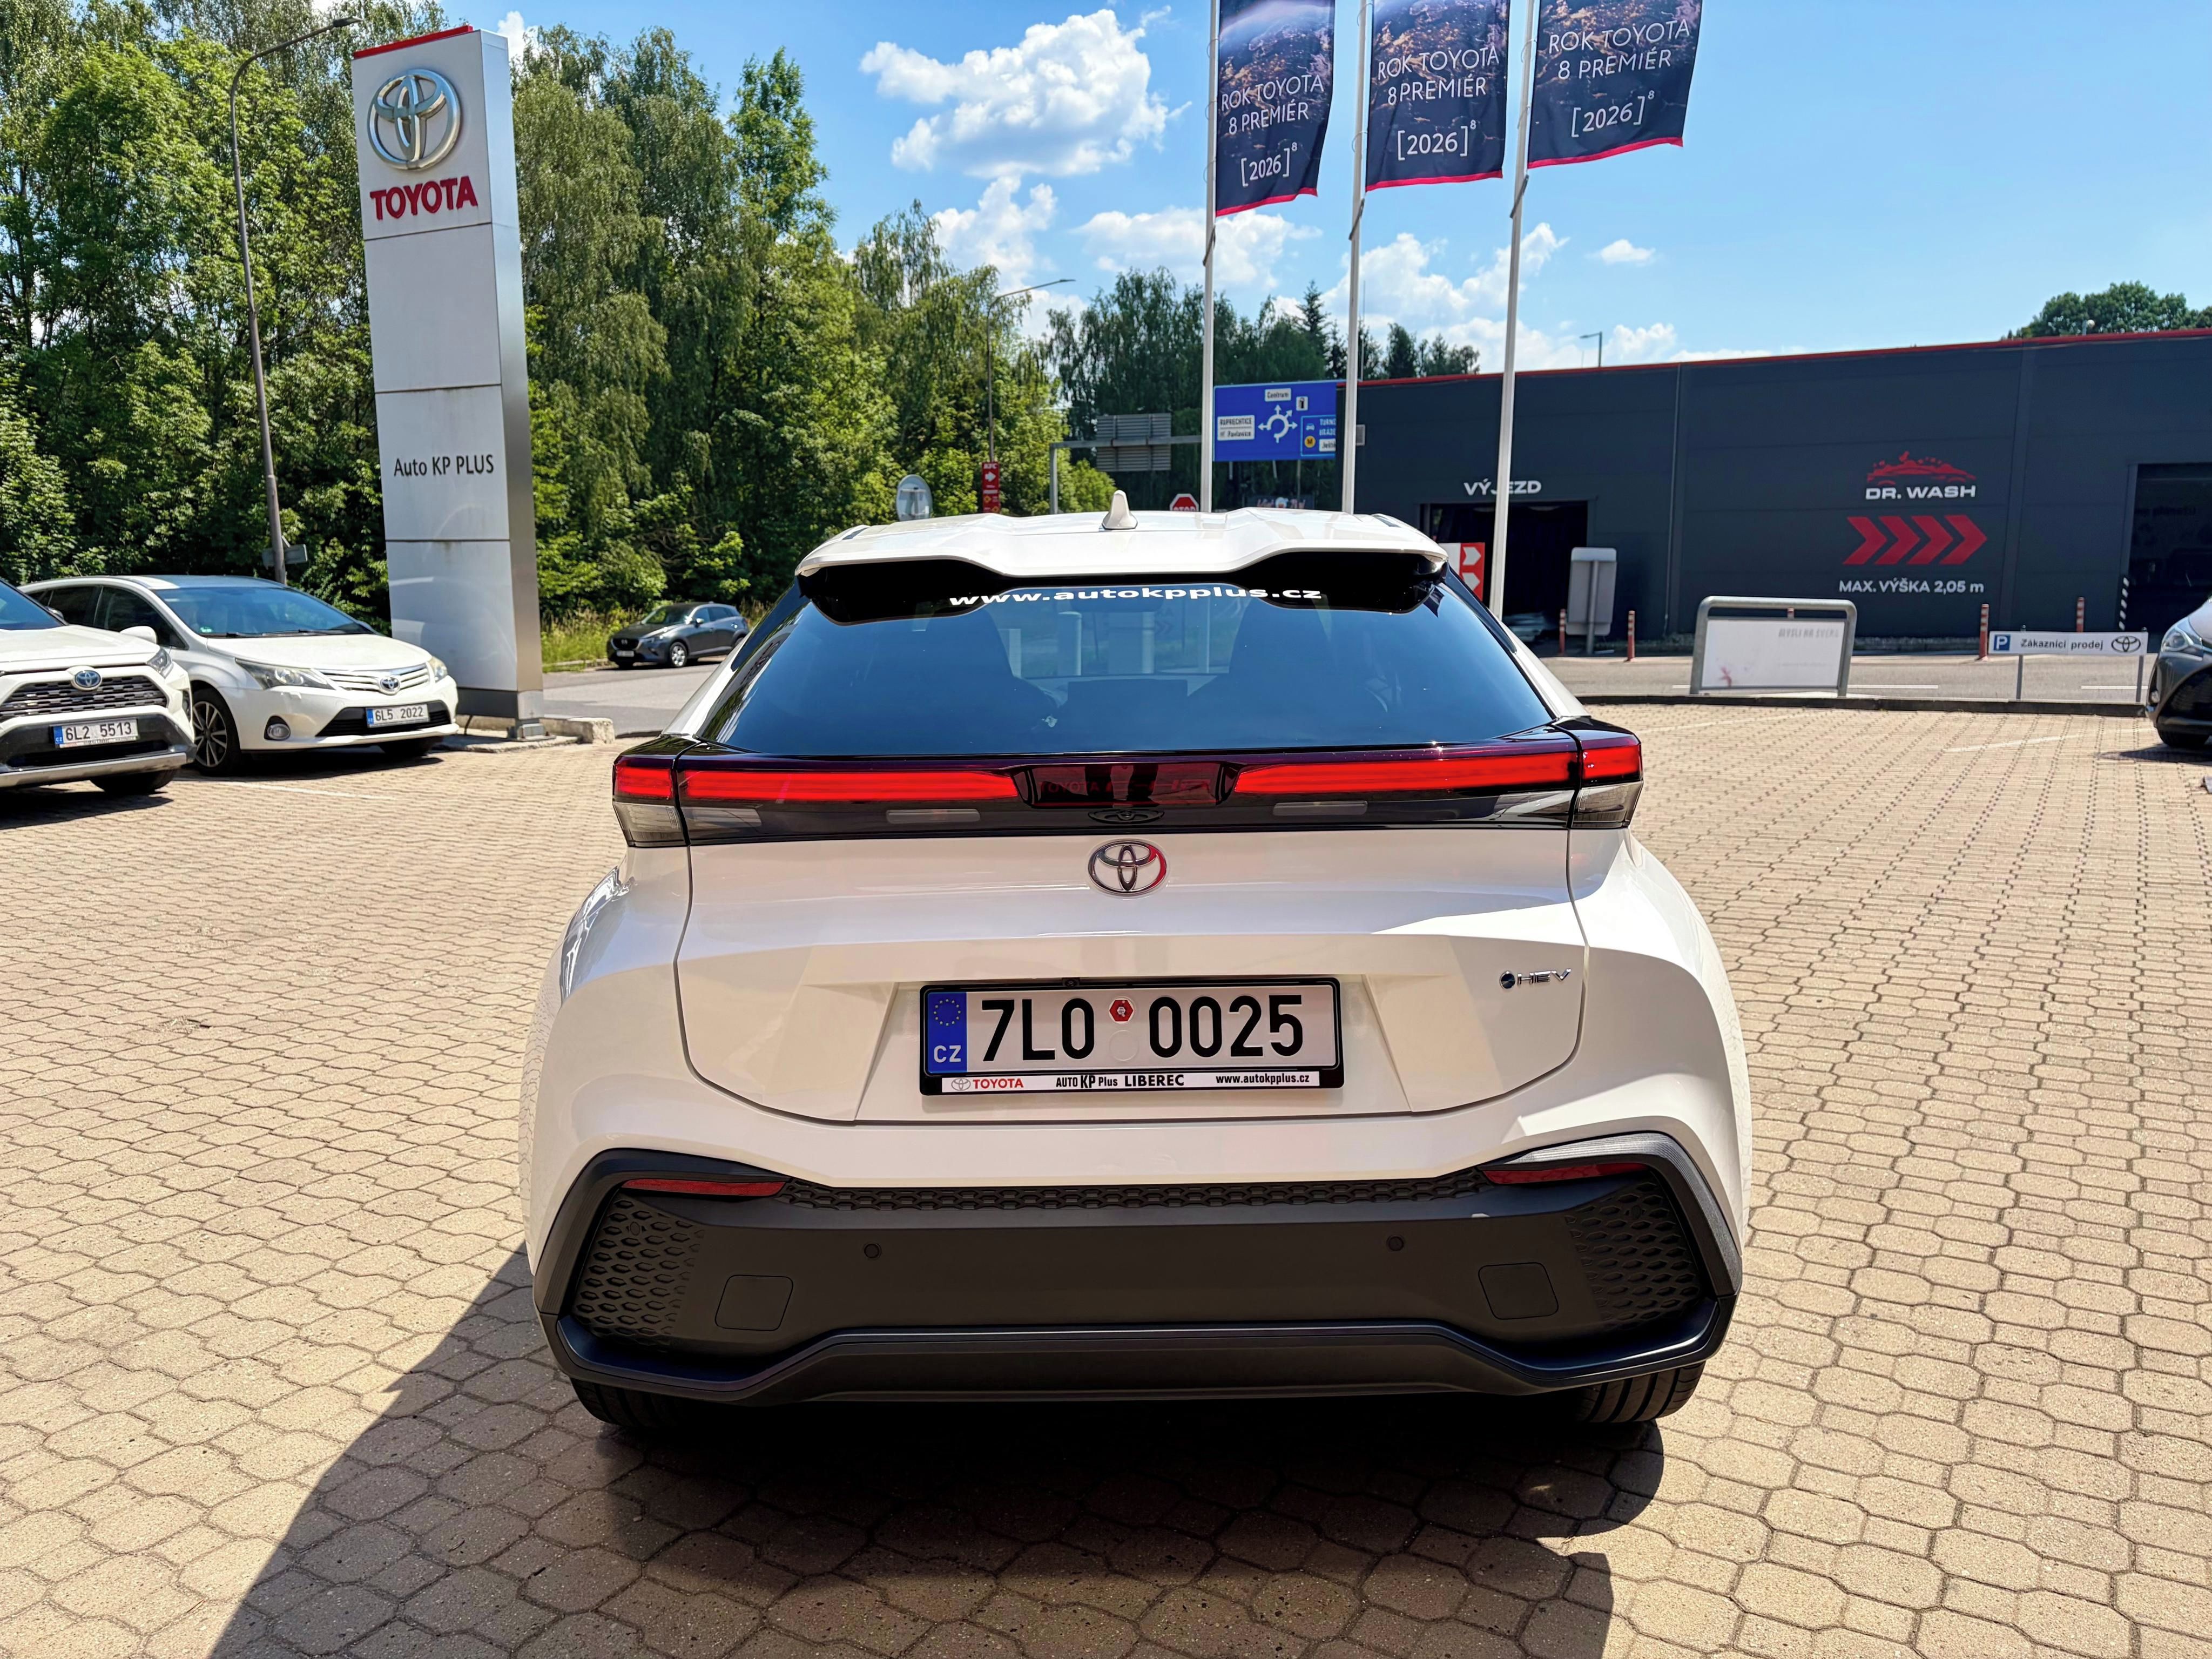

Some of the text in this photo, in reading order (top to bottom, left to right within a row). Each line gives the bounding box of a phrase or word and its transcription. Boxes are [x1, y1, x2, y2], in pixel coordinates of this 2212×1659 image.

[1549, 19, 1690, 54] ROK TOYOTA
[1378, 45, 1500, 80] ROK TOYOTA
[1558, 46, 1671, 79] 8 PREMIÉR
[1222, 74, 1324, 111] ROK TOYOTA
[1387, 73, 1486, 105] 8 PREMIÉR
[1229, 98, 1309, 135] 8 PREMIÉR
[370, 176, 478, 220] TOYOTA
[394, 454, 494, 477] Auto KP PLUS
[1865, 485, 1977, 500] DR. WASH
[949, 586, 1322, 605] www.autokpplus.cz
[1839, 577, 1984, 595] MAX. VÝŠKA 2,05 m
[1995, 635, 2008, 649] P
[2020, 638, 2103, 650] Zákazníci prodej
[375, 709, 393, 721] 6L5
[400, 706, 424, 719] 2022
[65, 721, 131, 741] 6L2 5513
[1518, 968, 1572, 986] HEV
[982, 994, 1303, 1062] 7L0 0025
[934, 1044, 962, 1063] CZ
[973, 1073, 1310, 1089] TOYOTA AUTO KP Plus LIBEREC www.autokpplus.cz
